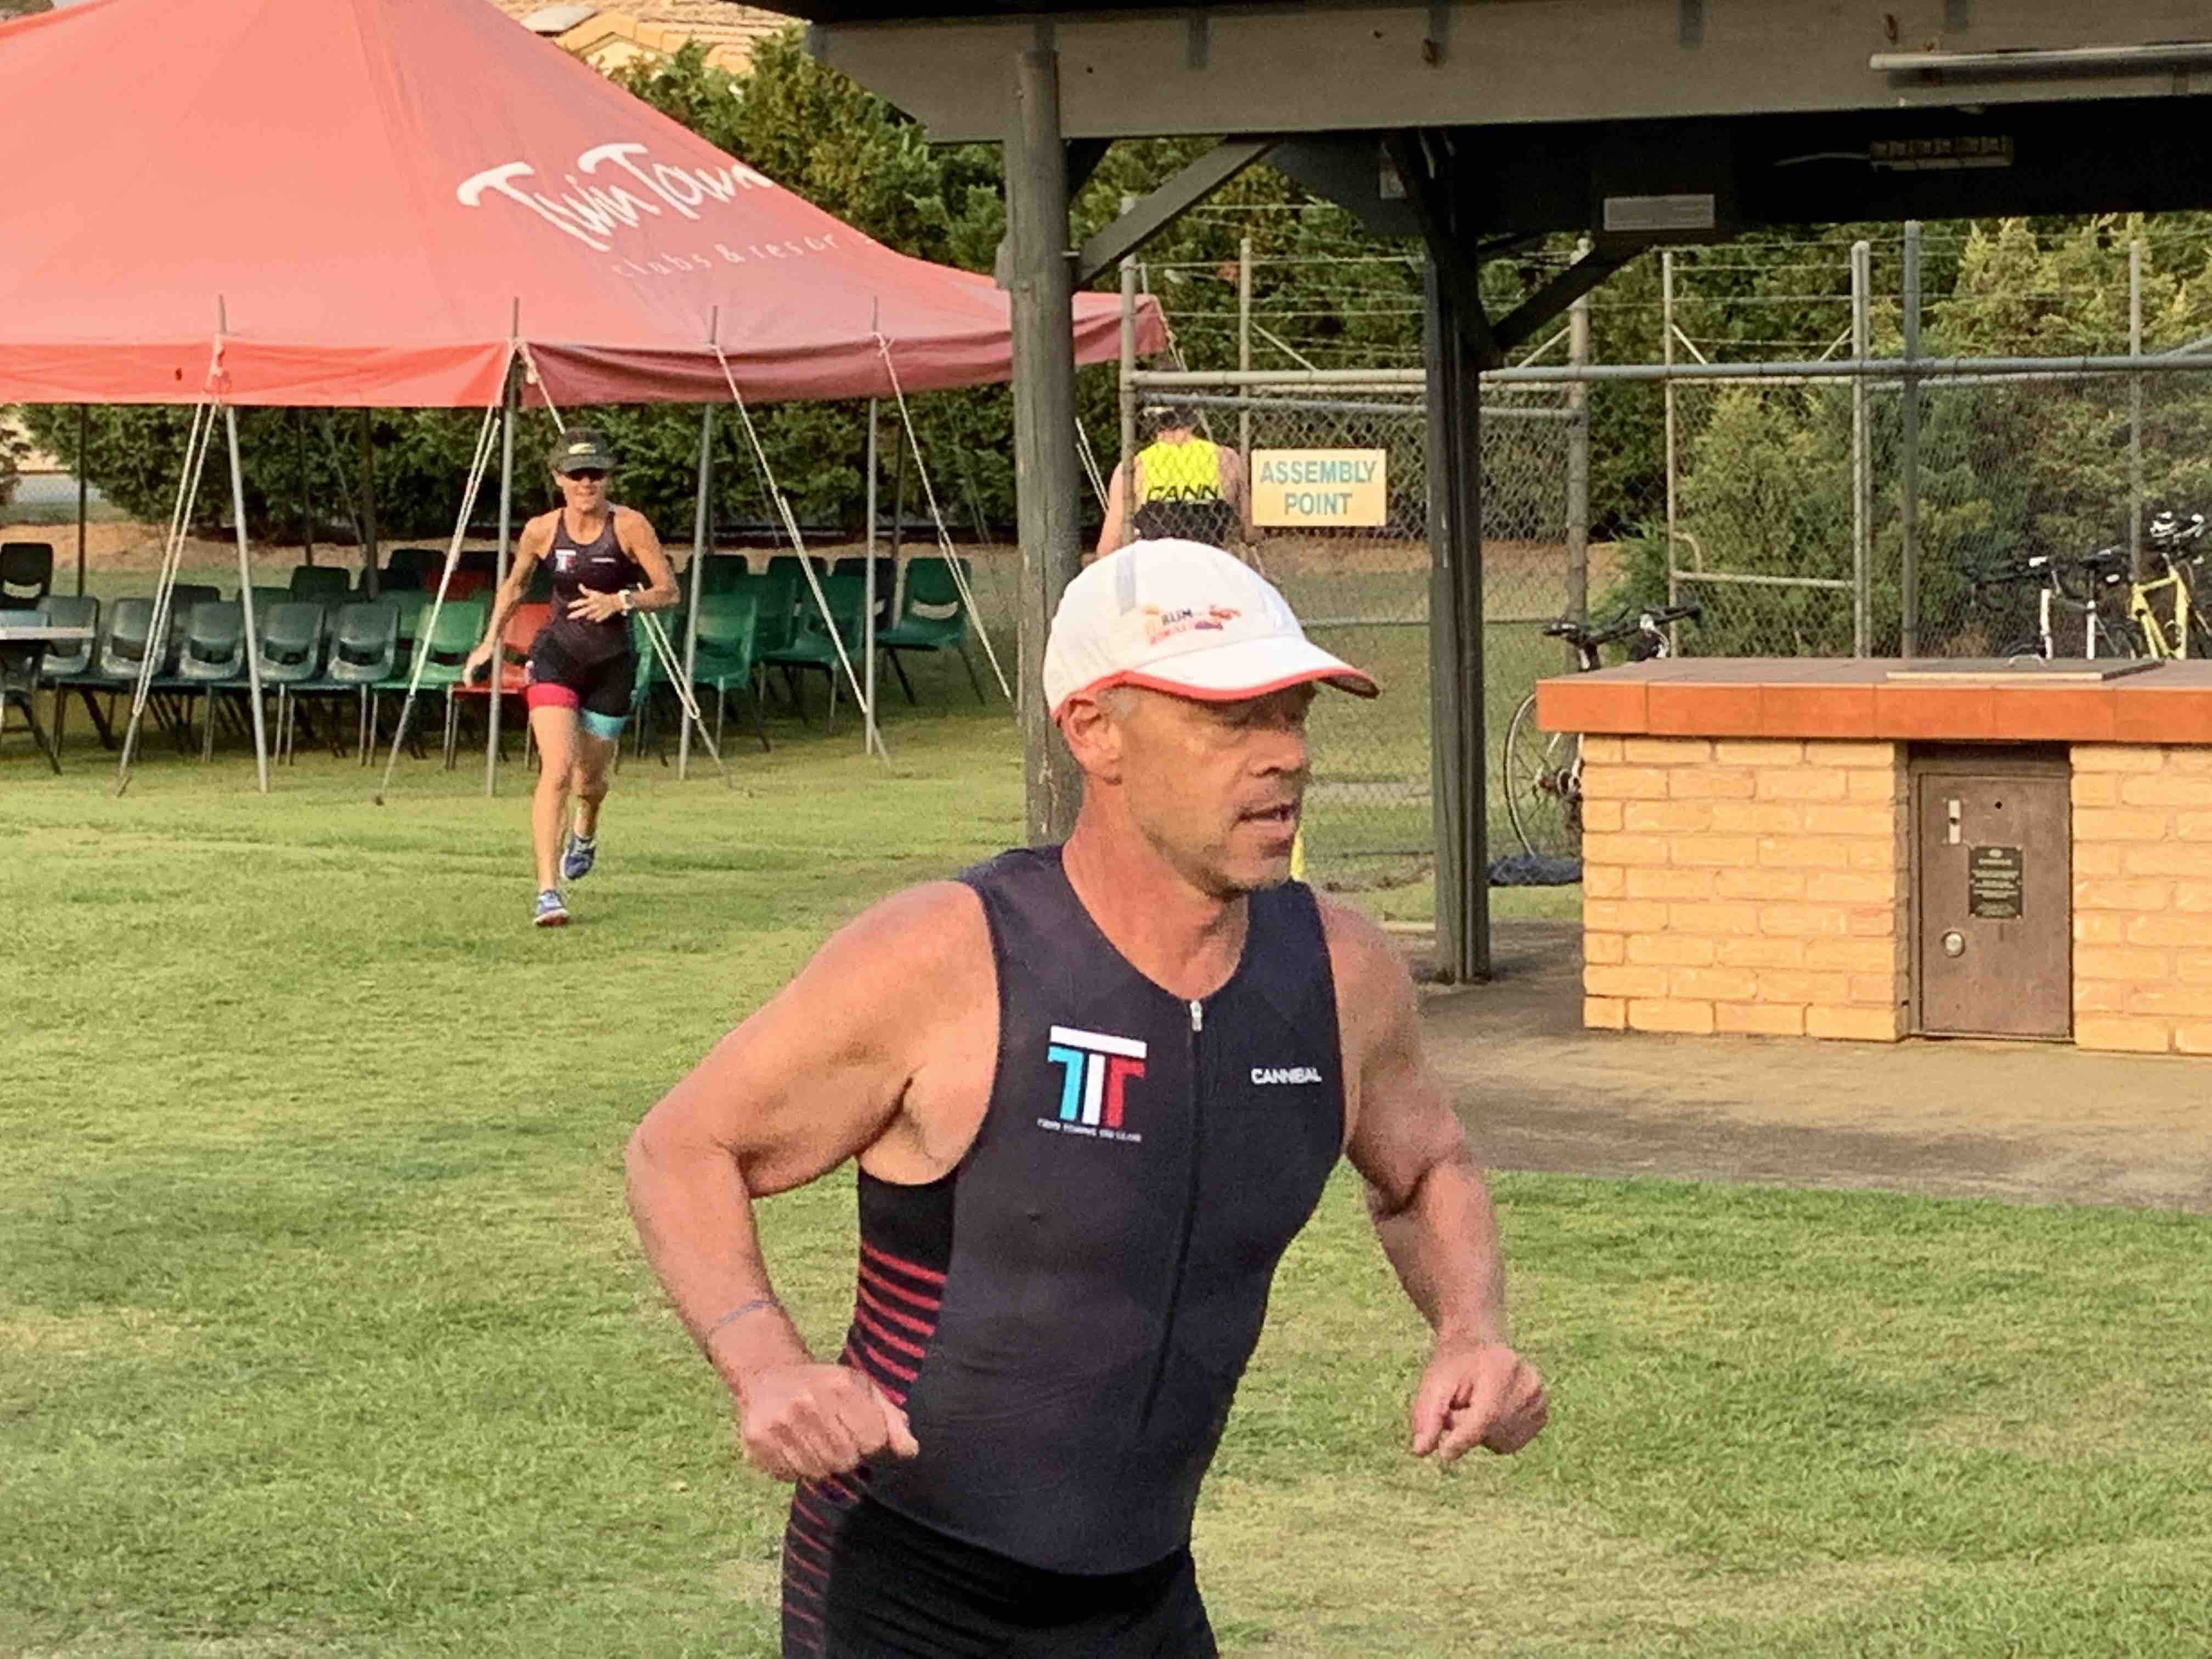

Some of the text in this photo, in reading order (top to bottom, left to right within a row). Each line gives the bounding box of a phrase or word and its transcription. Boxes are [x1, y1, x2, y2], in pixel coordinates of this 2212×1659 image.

[456, 161, 663, 252] Twin
[714, 243, 746, 263] &
[748, 232, 874, 259] resor
[1260, 460, 1377, 484] ASSEMBLY
[1284, 492, 1352, 516] POINT
[1250, 1067, 1322, 1085] CANNIBAL
